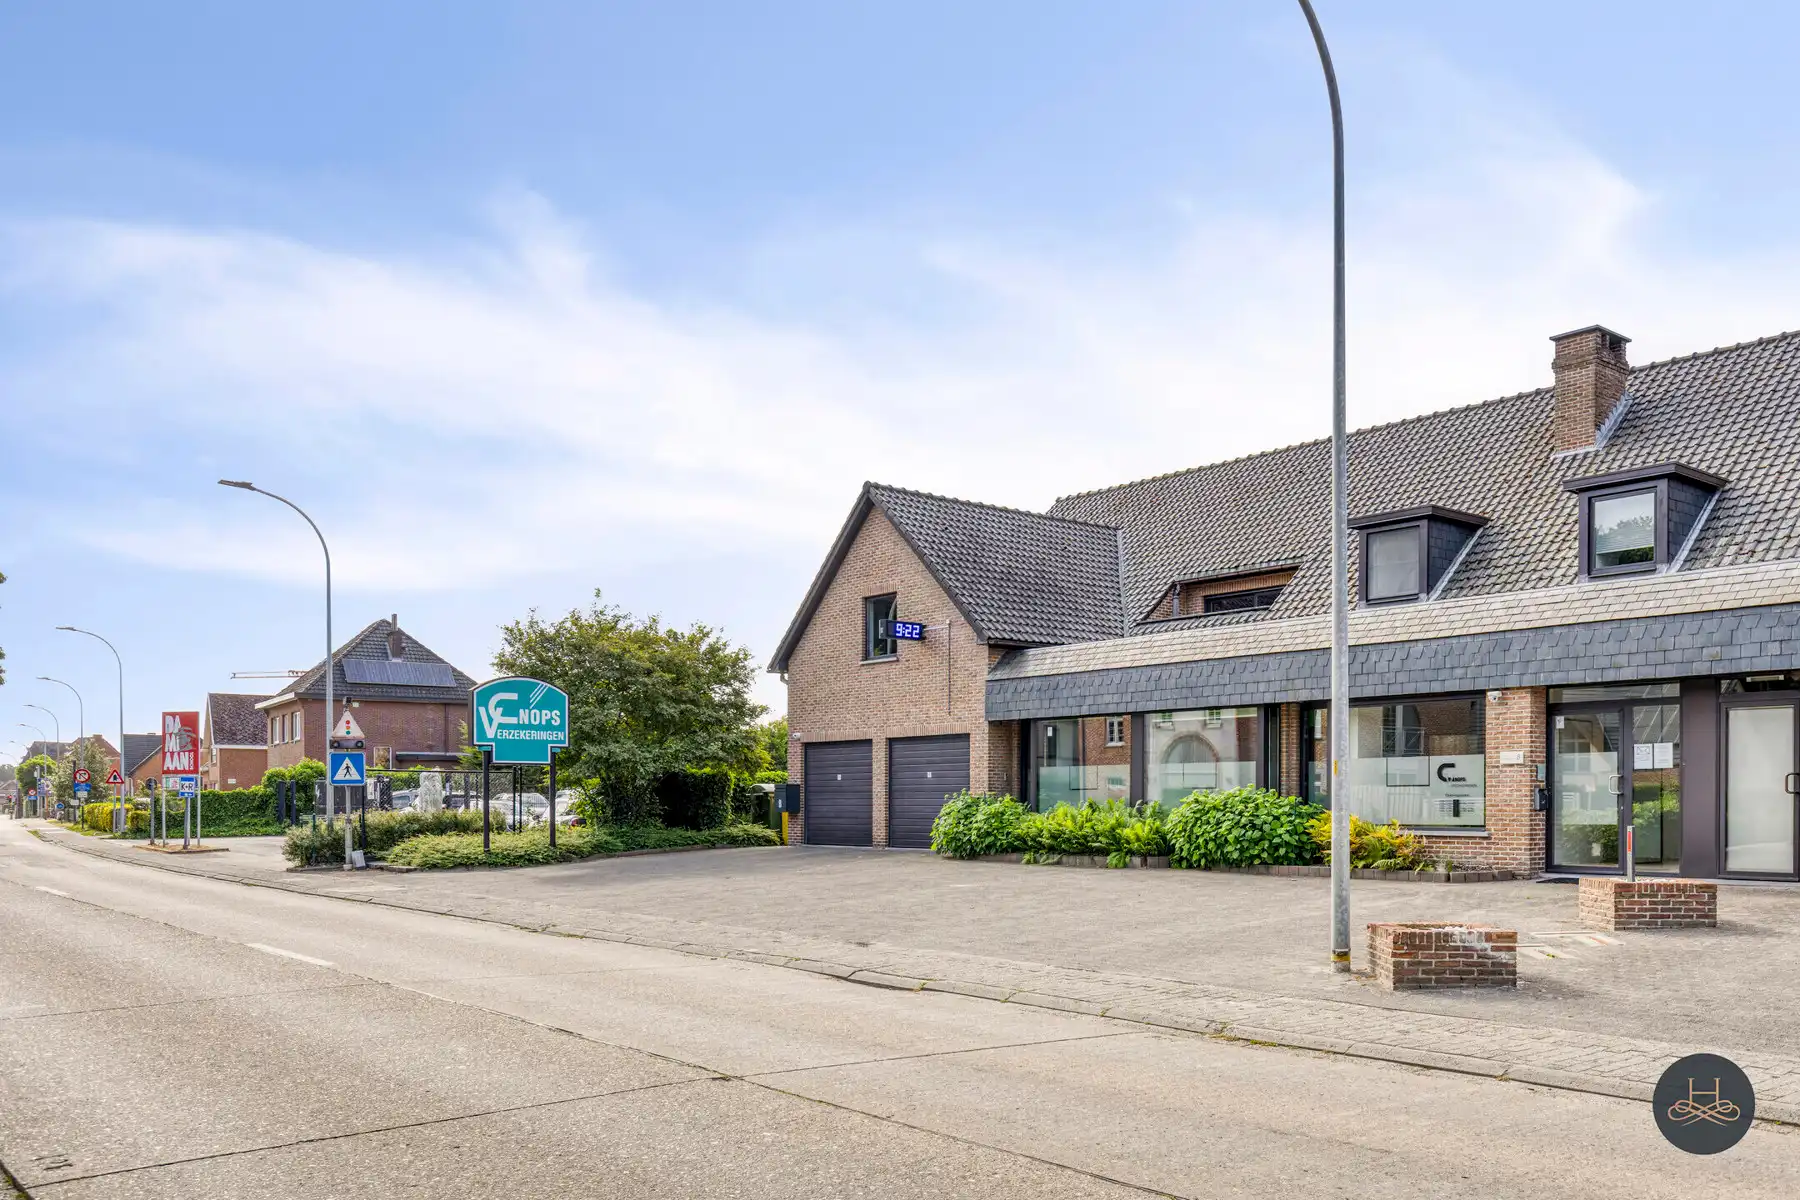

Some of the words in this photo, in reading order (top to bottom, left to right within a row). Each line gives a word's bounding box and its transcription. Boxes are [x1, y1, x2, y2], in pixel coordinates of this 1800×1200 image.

[895, 623, 920, 638] 9:22
[165, 715, 181, 733] DA
[163, 752, 189, 771] AAN
[180, 782, 193, 791] K+R
